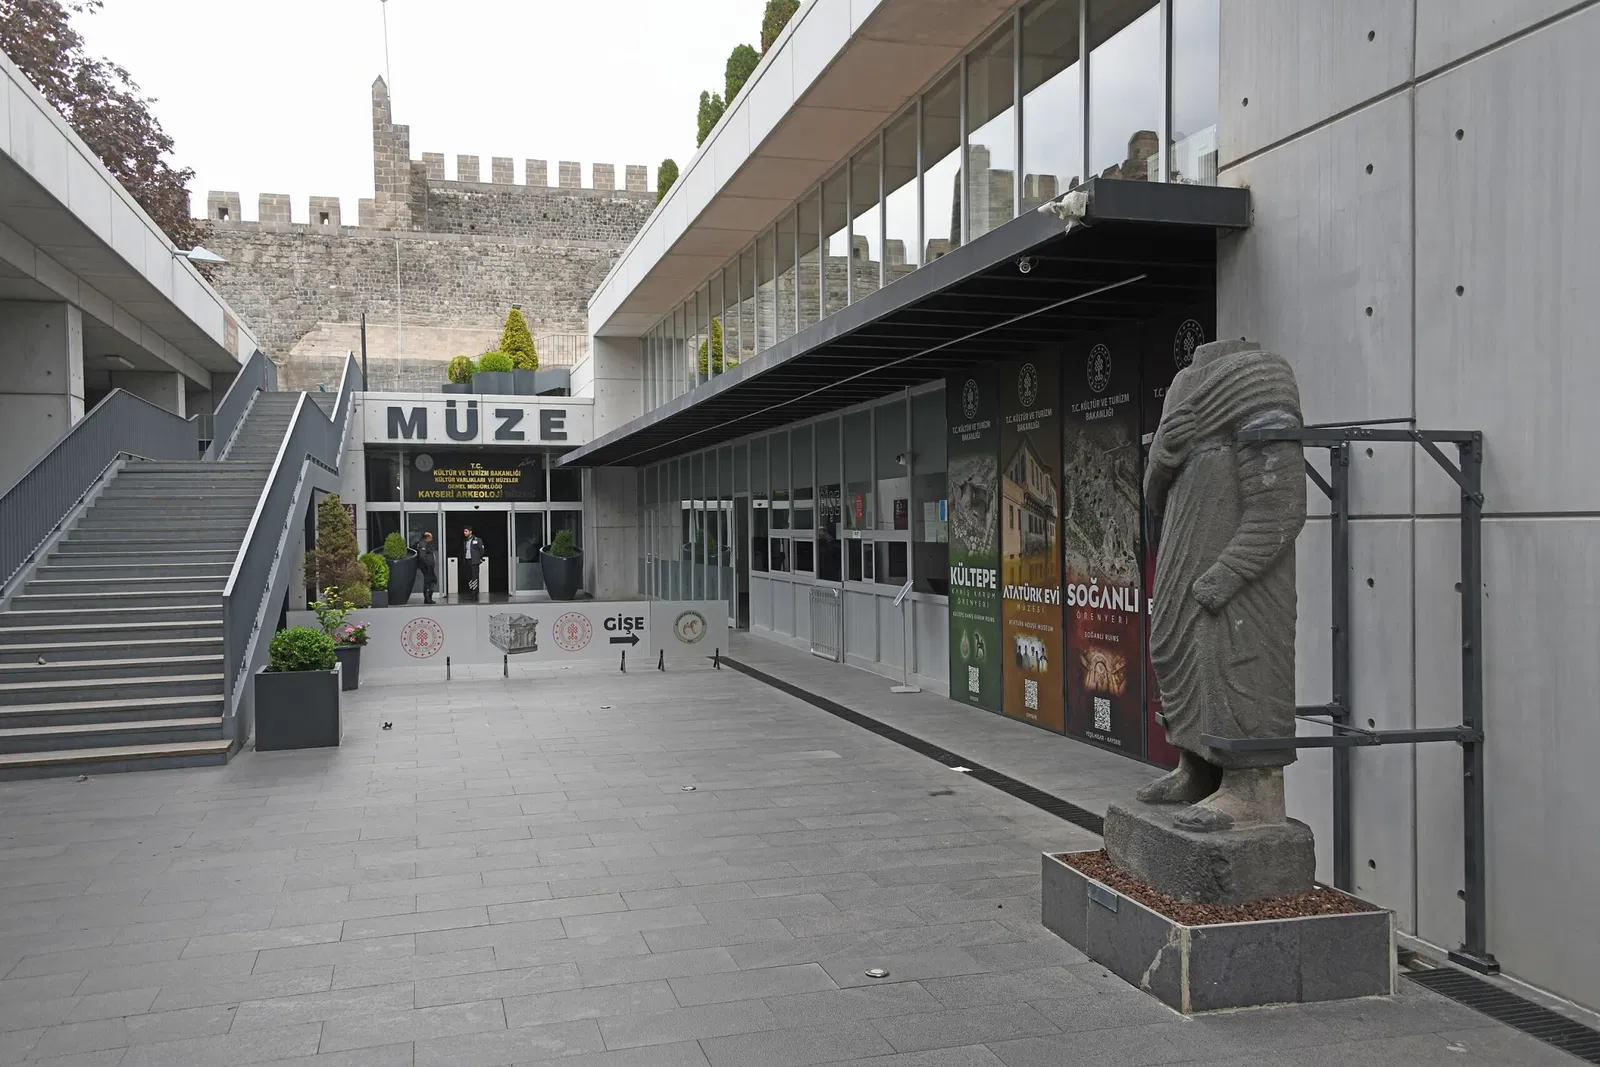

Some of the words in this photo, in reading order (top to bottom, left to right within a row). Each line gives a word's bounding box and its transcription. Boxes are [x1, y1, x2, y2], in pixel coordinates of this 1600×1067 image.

[1153, 387, 1164, 398] T.C.
[1071, 403, 1080, 412] T.C.
[1081, 398, 1100, 411] KÜLTÜR
[1101, 397, 1108, 407] VE
[1108, 392, 1130, 404] TURİZM
[387, 400, 567, 441] MÜZE
[1005, 415, 1013, 424] T.C.
[1013, 411, 1029, 422] KÜLTÜR
[1029, 411, 1035, 419] VE
[1035, 407, 1053, 418] TURİZM
[1085, 407, 1114, 421] BAKANLIĞI
[1016, 420, 1040, 432] BAKANLIĞI
[418, 489, 454, 498] KAYSERİ
[456, 489, 503, 498] ARKEOLOJİ
[950, 561, 997, 589] KÜLTEPE
[1003, 582, 1042, 603] ATATÜRK
[1044, 585, 1060, 605] EVİ
[1067, 577, 1139, 613] SOĞANLI
[603, 613, 644, 634] GİŞE
[1076, 610, 1128, 625] ÖRENYERİ
[1084, 631, 1104, 640] SOĞANLI
